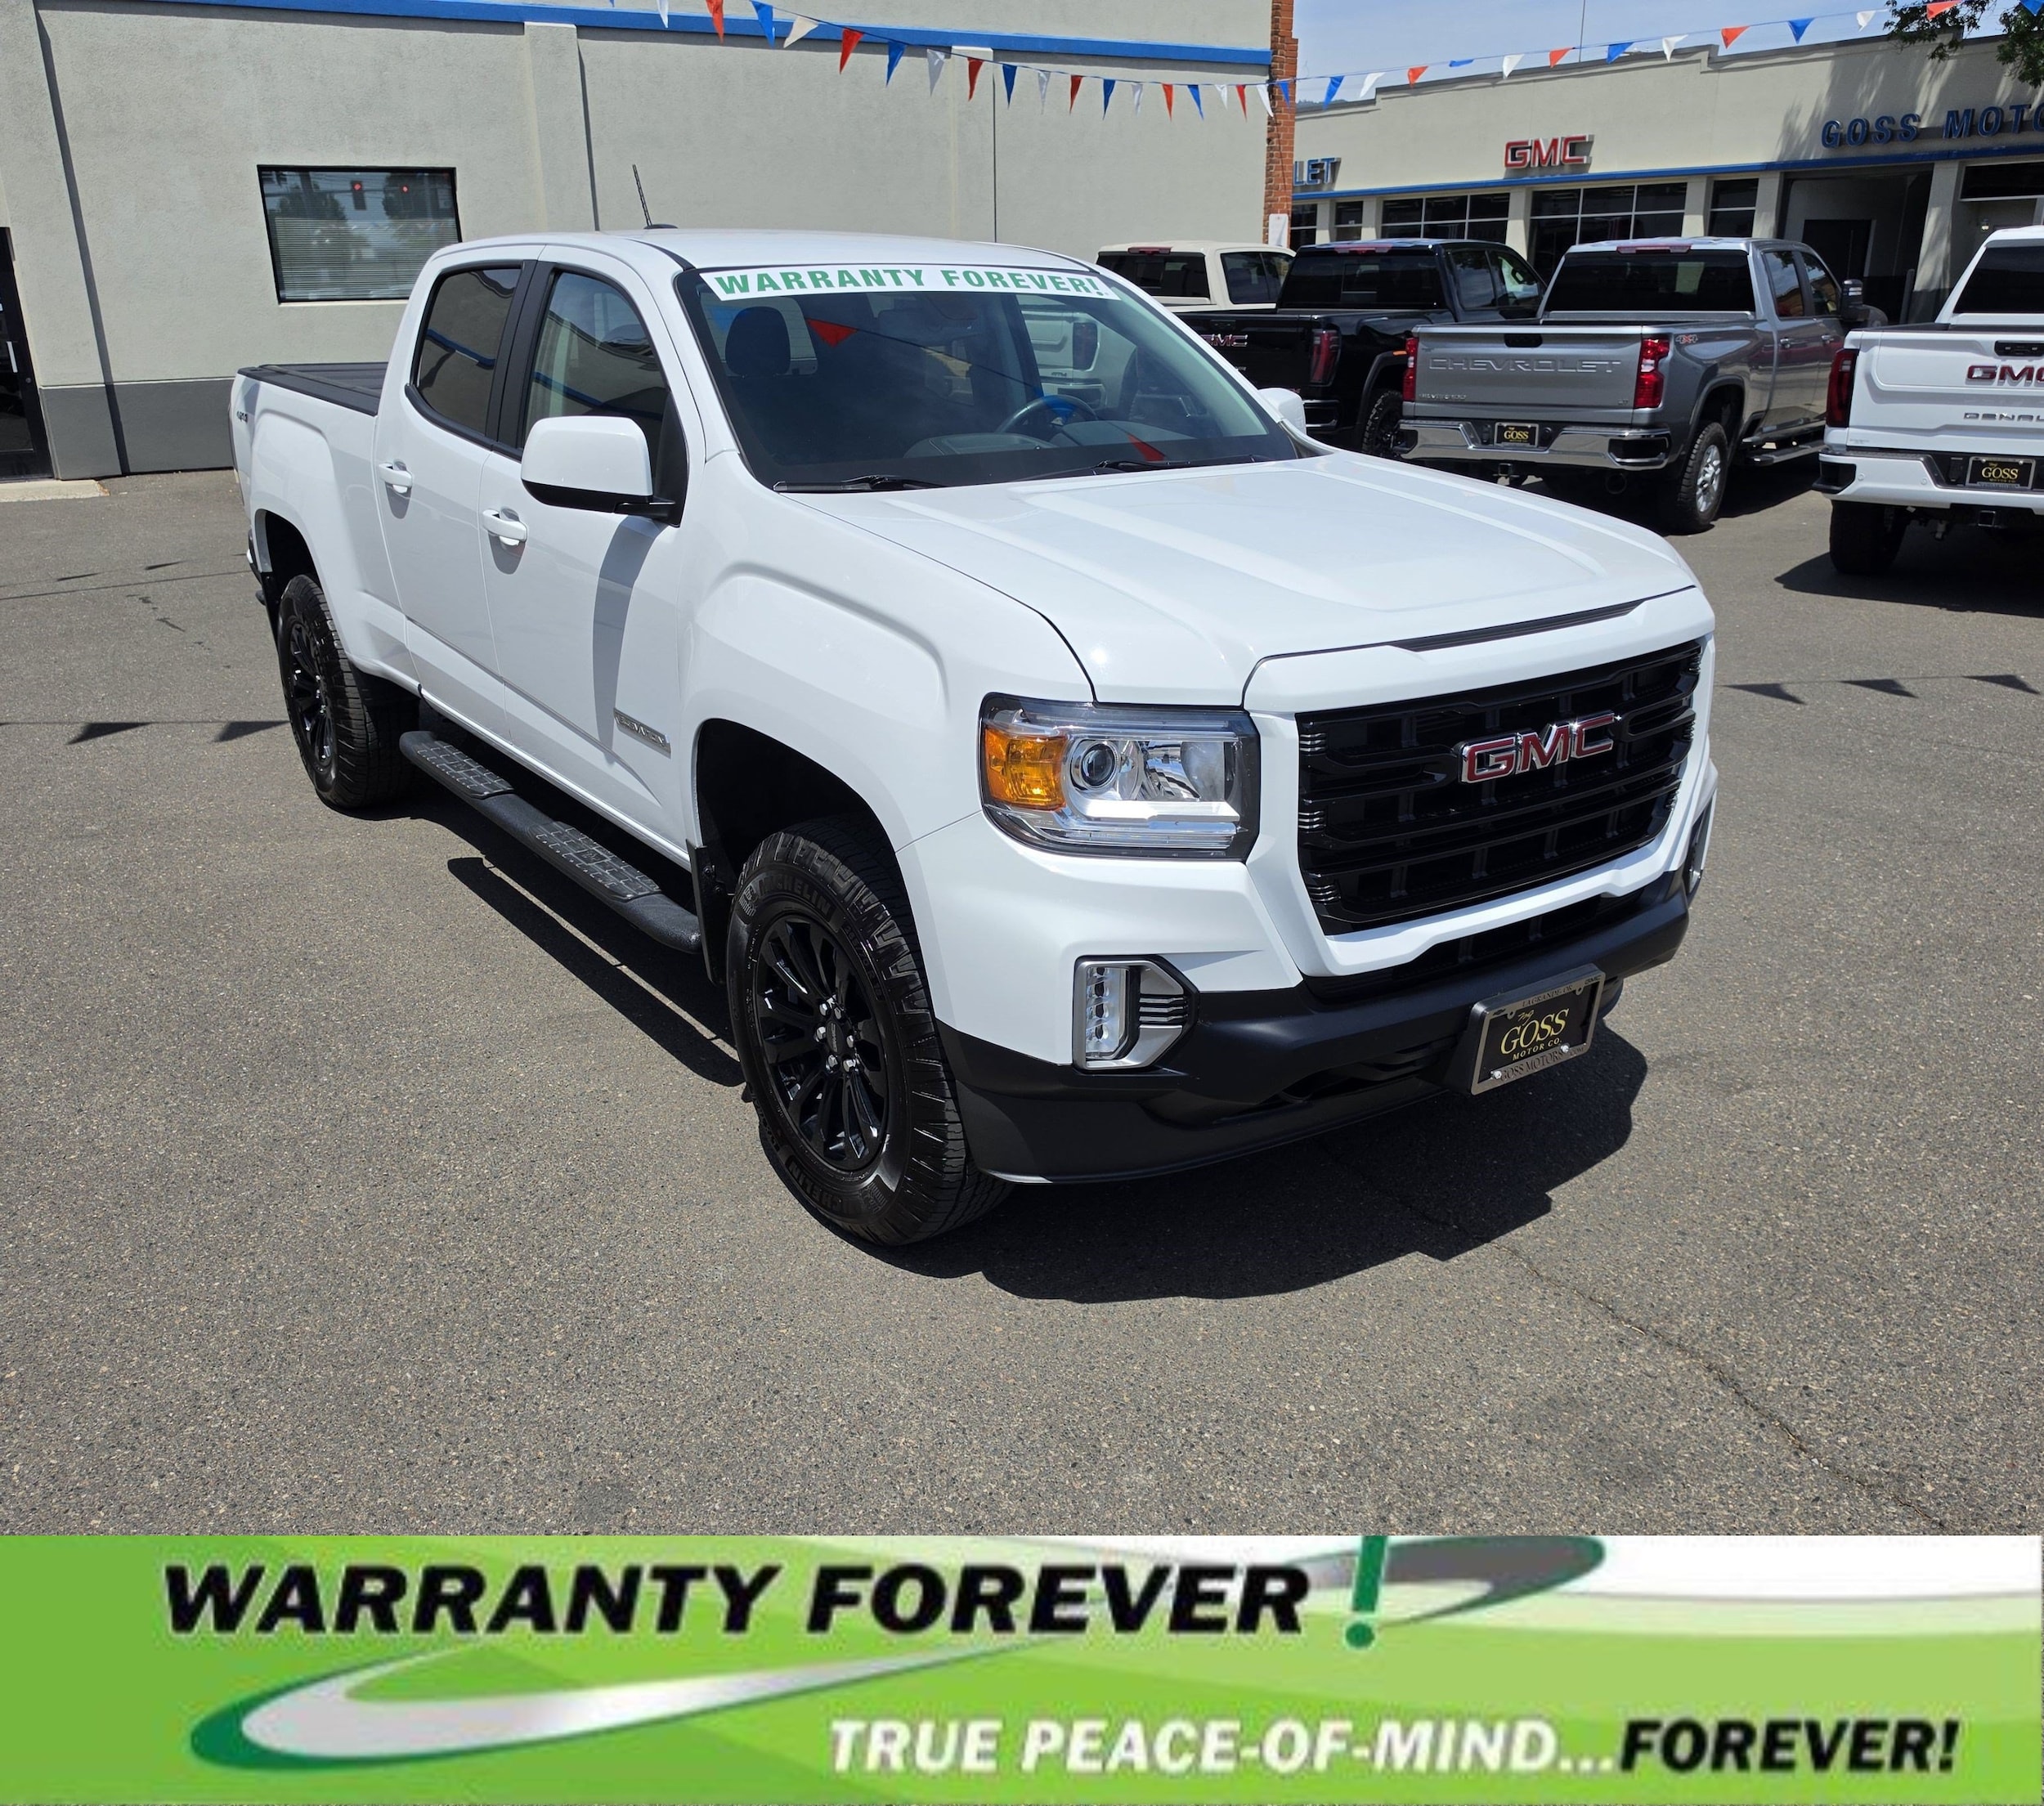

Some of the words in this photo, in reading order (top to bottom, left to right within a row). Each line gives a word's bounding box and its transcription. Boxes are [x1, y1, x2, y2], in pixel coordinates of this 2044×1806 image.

[1821, 113, 1921, 149] GOSS
[1504, 134, 1594, 169] GMC
[713, 268, 923, 294] WARRANTY
[939, 269, 1104, 296] FOREVER!
[1429, 359, 1621, 373] CHEVROLET
[1966, 365, 2044, 384] GM
[1504, 430, 1529, 440] GOSS
[1981, 467, 2019, 480] GOSS
[1459, 711, 1615, 784] GMC
[759, 874, 834, 918] MICHELIN
[1500, 1008, 1569, 1055] GOSS
[1513, 1043, 1544, 1061] MOTOR
[1548, 1037, 1562, 1047] CO.
[1501, 1063, 1524, 1081] GOSS
